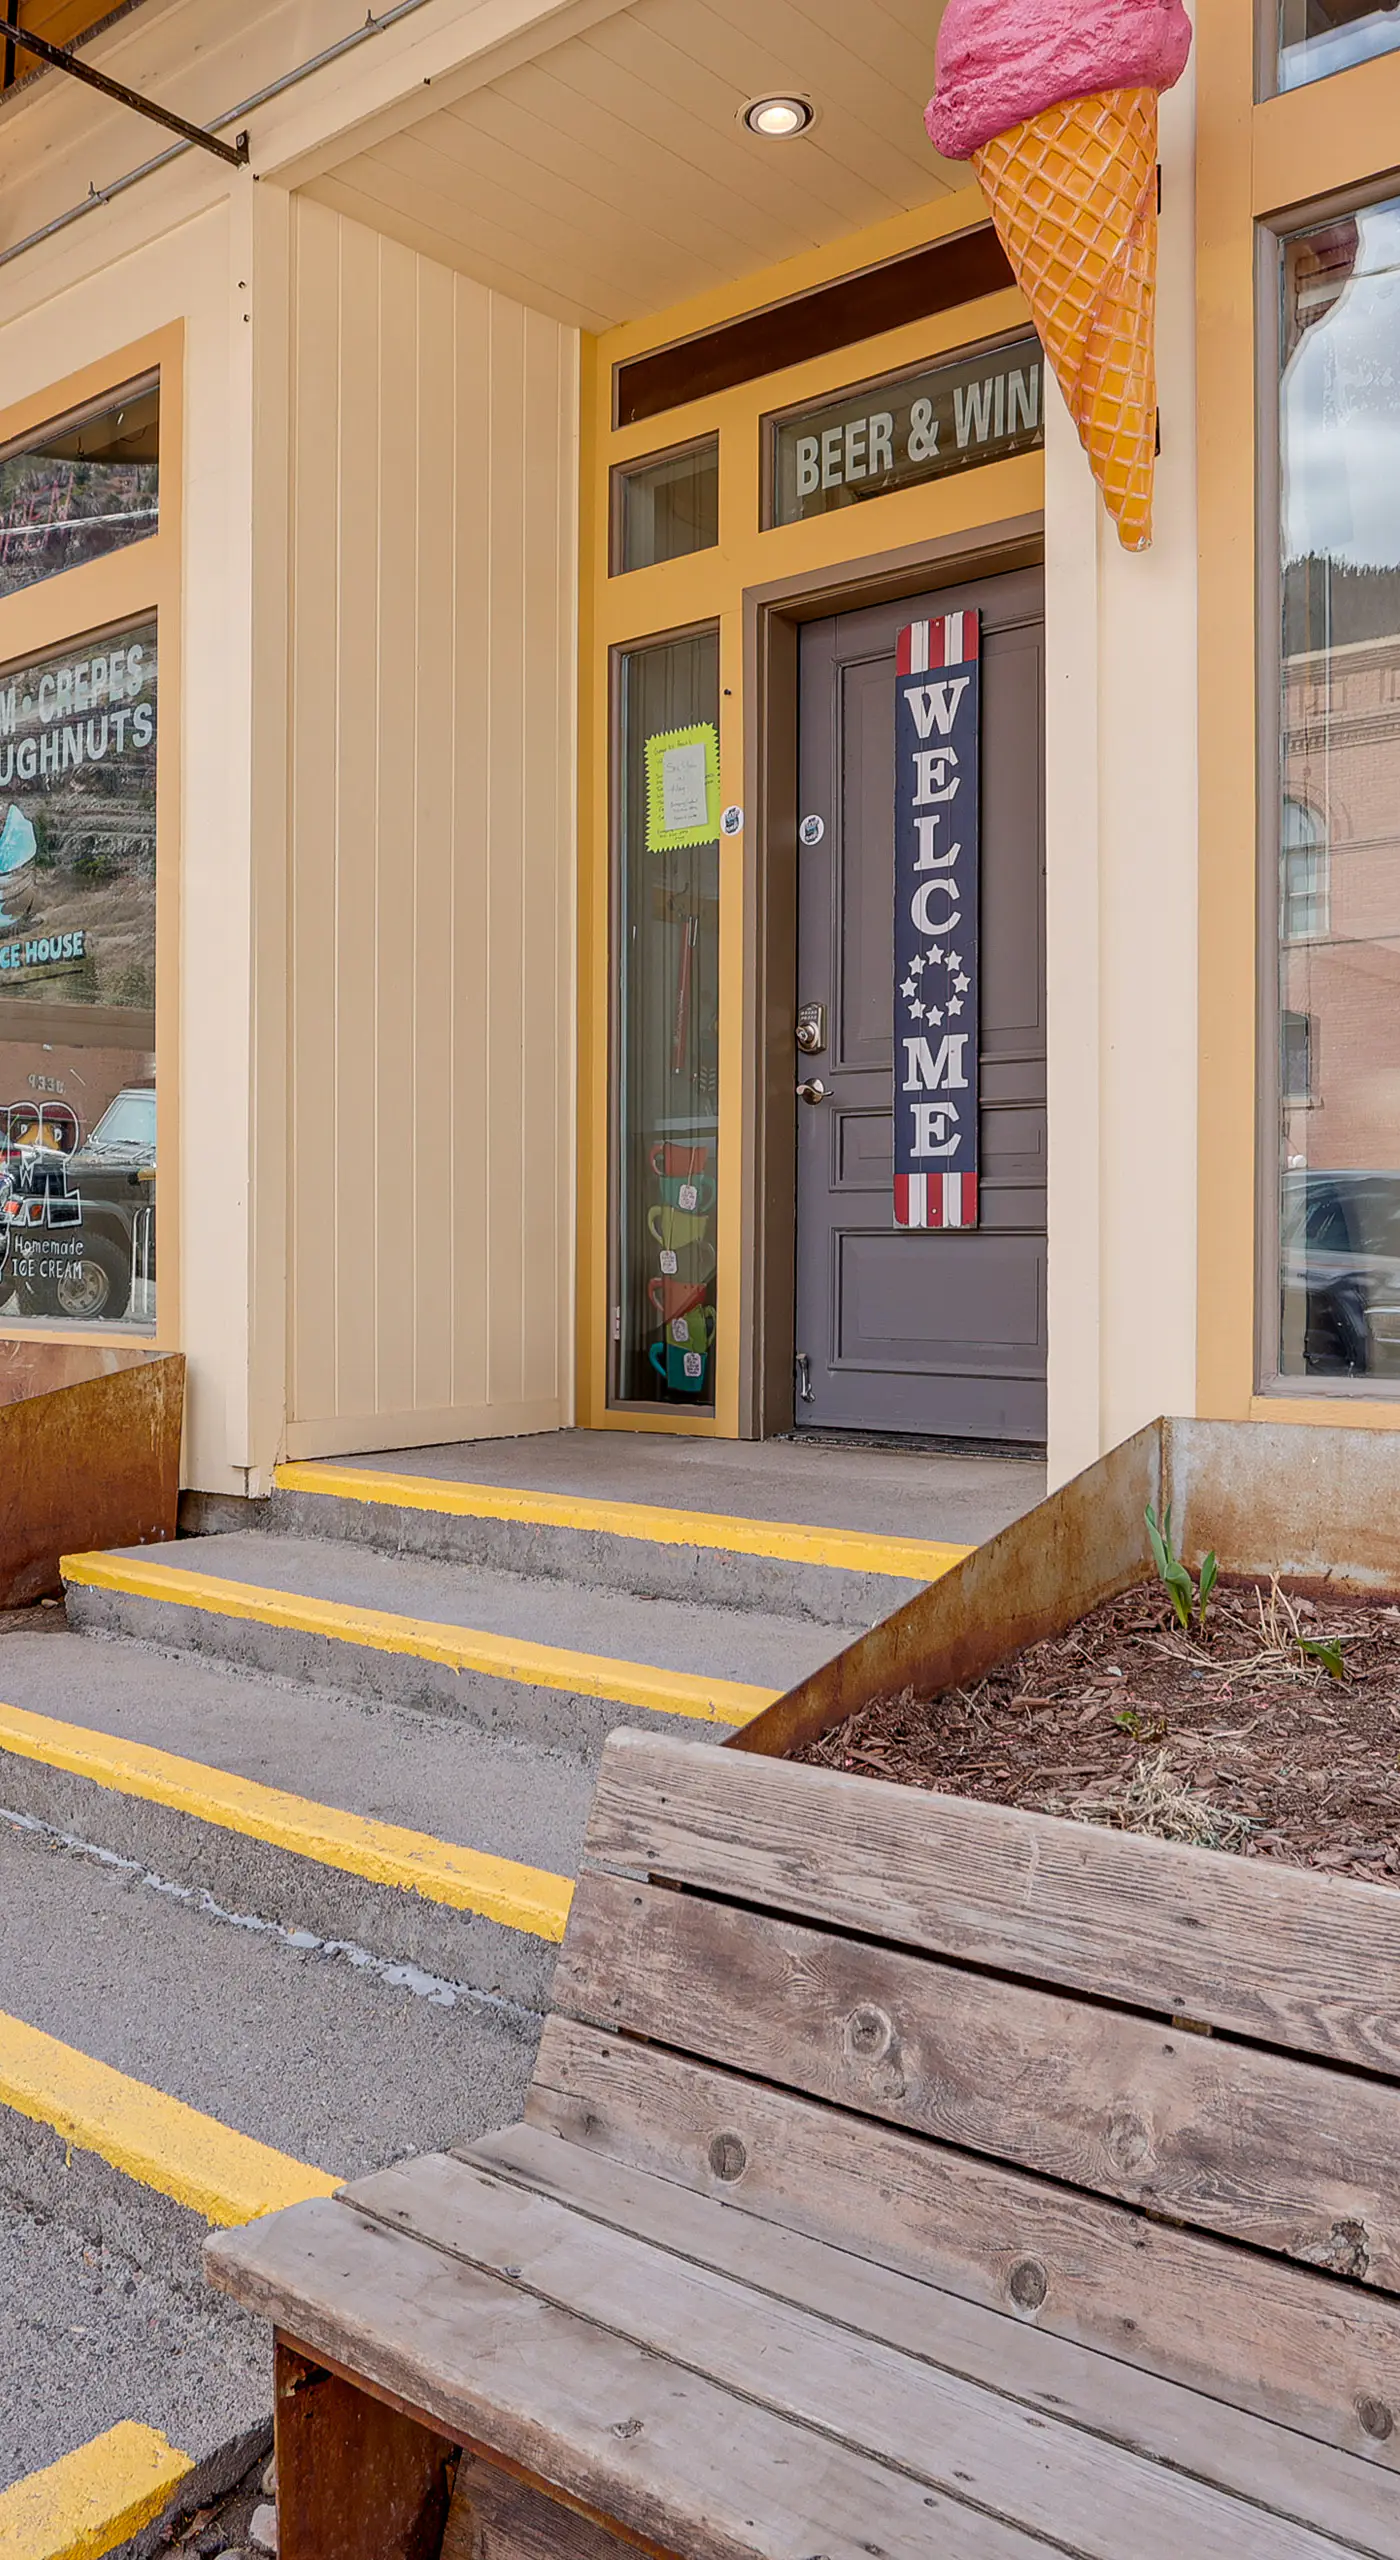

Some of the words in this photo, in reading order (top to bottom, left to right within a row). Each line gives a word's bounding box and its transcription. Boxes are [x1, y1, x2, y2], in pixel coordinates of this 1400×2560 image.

[796, 411, 894, 497] BEER
[907, 398, 940, 462] &
[953, 363, 1044, 449] WIN
[38, 644, 144, 723] CREPES
[900, 675, 971, 1158] WELCOME
[25, 930, 84, 964] HOUSE
[12, 1258, 35, 1277] ICE
[40, 1260, 82, 1280] CREAM
[15, 1236, 84, 1256] Homemade
